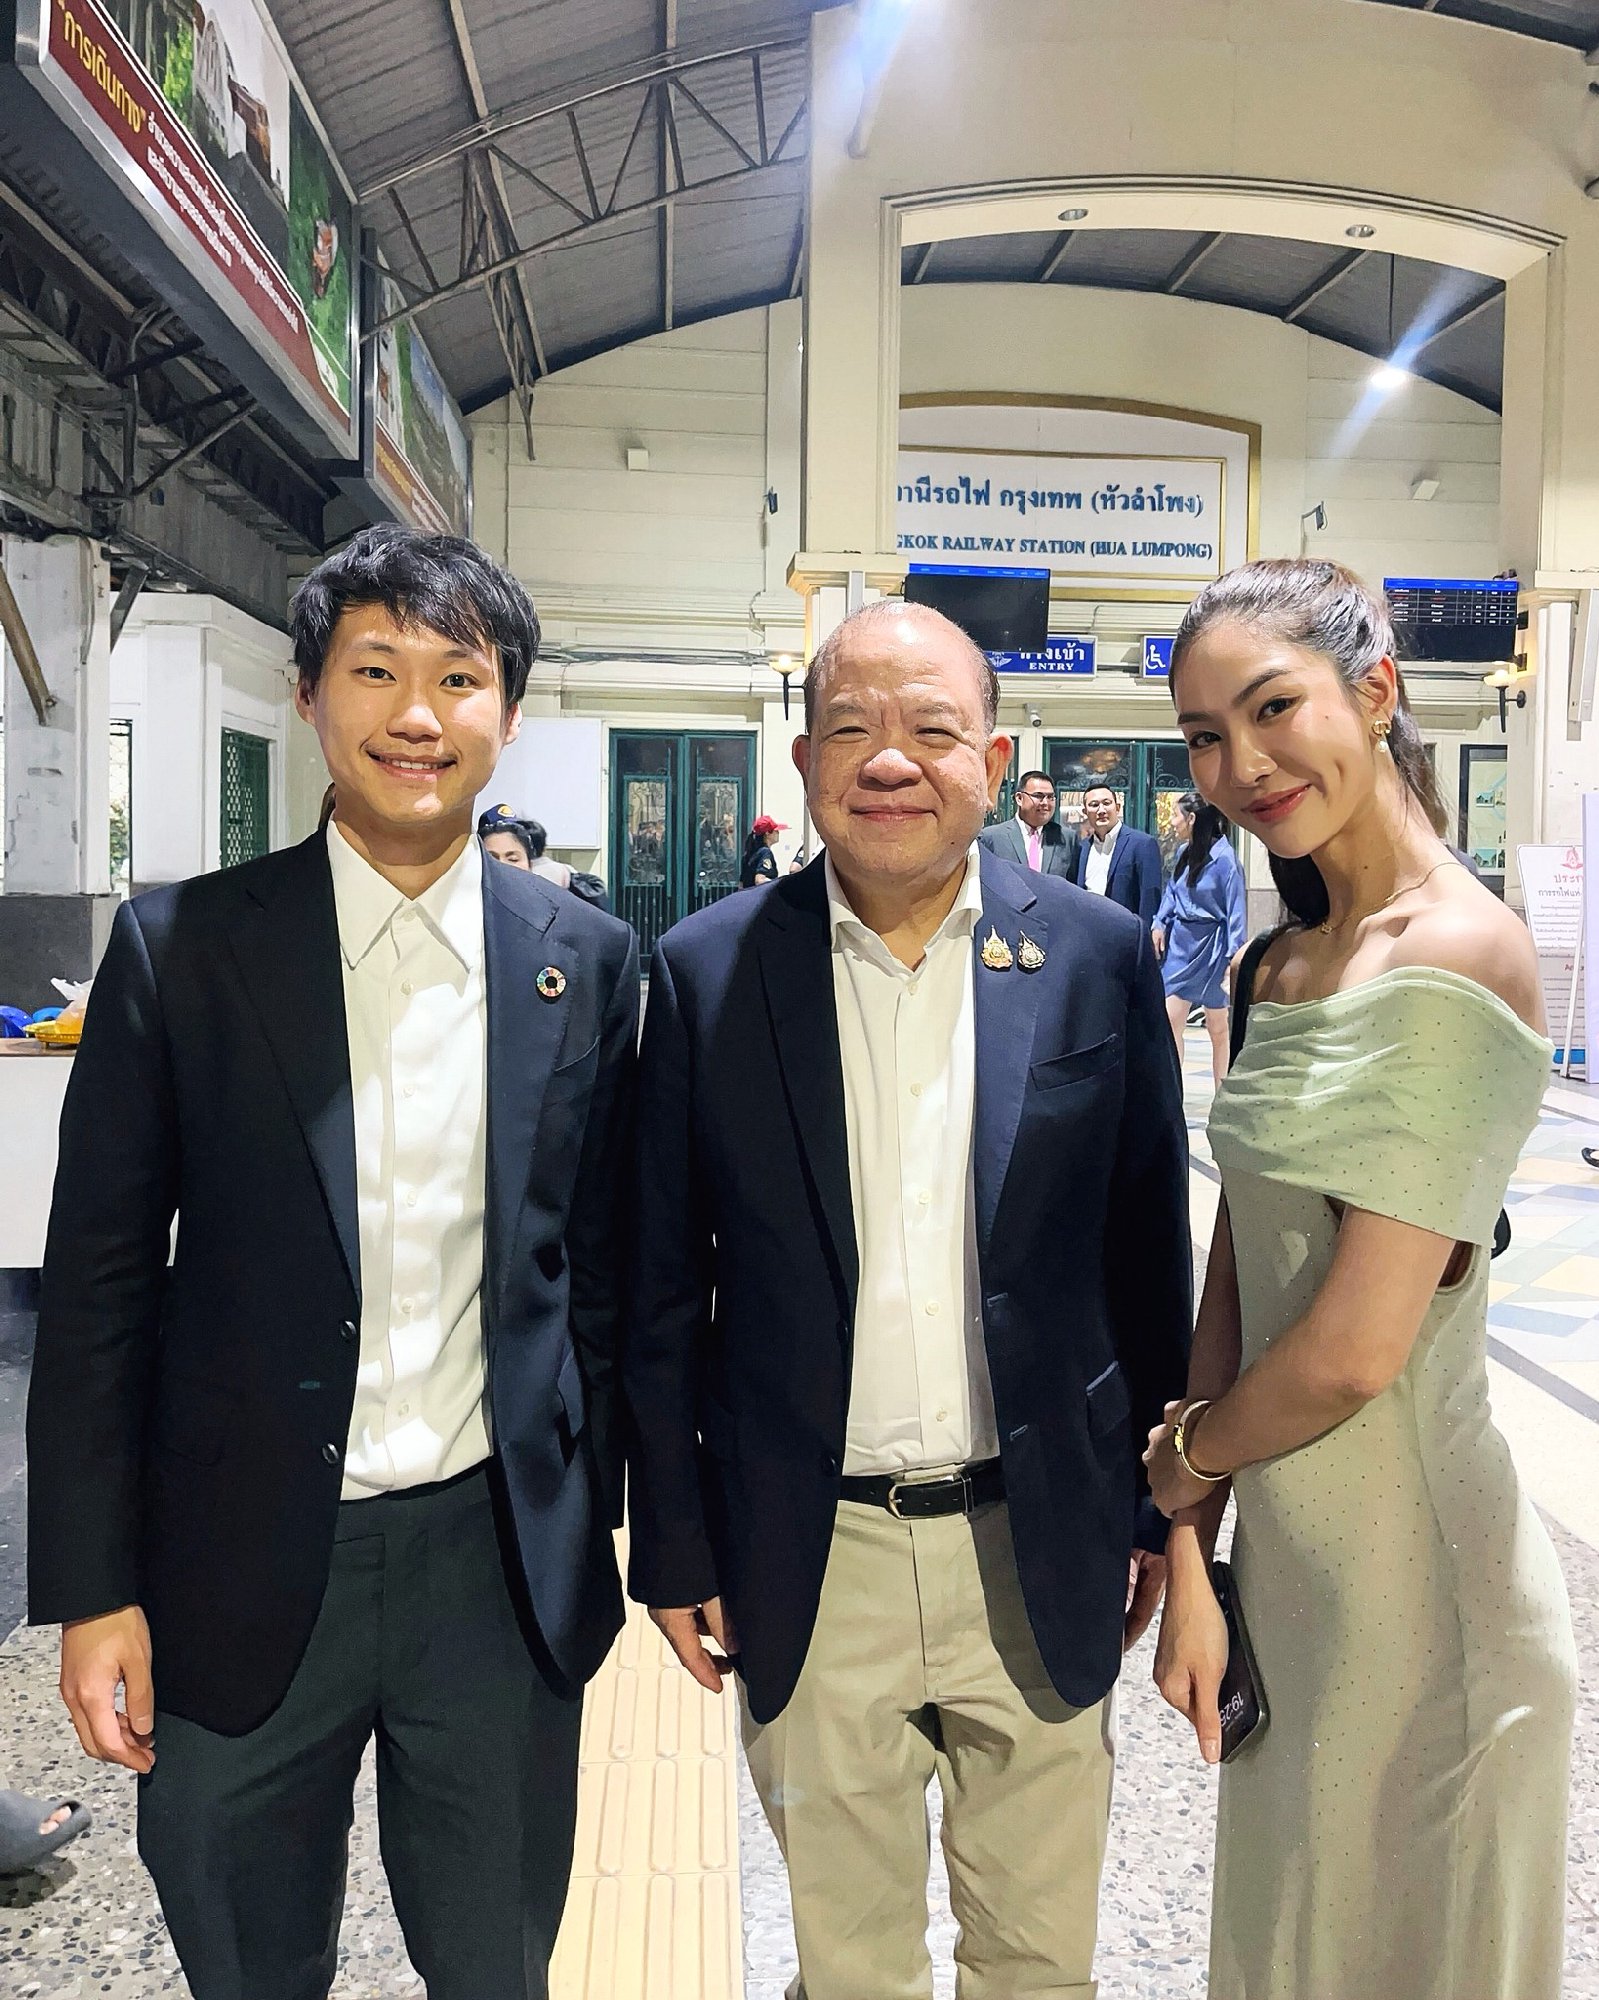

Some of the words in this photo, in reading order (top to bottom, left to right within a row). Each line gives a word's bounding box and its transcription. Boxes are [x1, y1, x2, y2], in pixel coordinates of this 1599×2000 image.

[897, 475, 990, 506] านีรถไฟ
[1000, 489, 1082, 515] กรุงเทพ
[1091, 484, 1204, 518] (หัวลำโพง)
[943, 535, 1016, 552] RAILWAY
[1020, 538, 1085, 554] STATION
[1090, 540, 1127, 557] (HUA
[1132, 541, 1213, 560] LUMPONG)
[1029, 662, 1074, 671] ENTRY
[1219, 1691, 1244, 1727] 19:25
